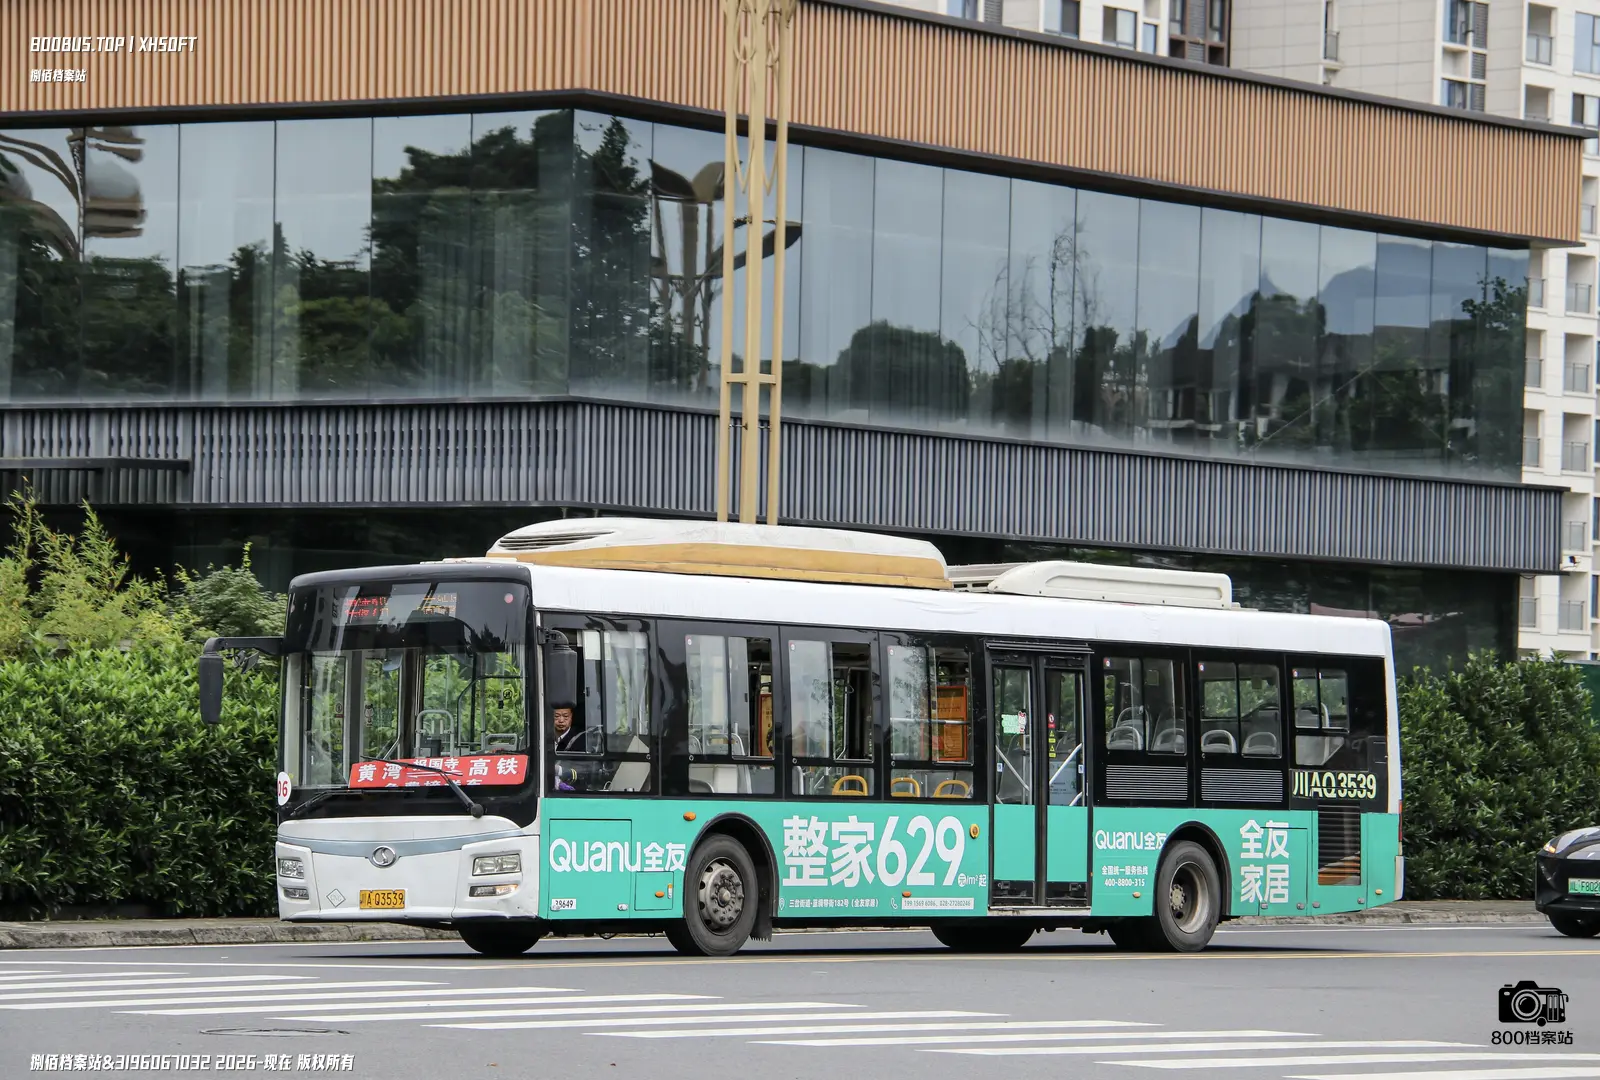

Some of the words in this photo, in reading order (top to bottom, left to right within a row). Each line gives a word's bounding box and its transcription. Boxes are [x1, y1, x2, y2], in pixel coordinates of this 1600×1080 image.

[357, 763, 402, 782] 黄湾
[468, 757, 518, 776] 高铁
[1292, 771, 1377, 799] 川AQ3539
[782, 815, 966, 888] 整家629
[1095, 829, 1167, 851] Quanu全友
[1240, 819, 1290, 859] 全友
[549, 838, 686, 873] Quanu全友
[1101, 865, 1149, 876] 全国统一服务热线
[1240, 864, 1290, 903] 家居
